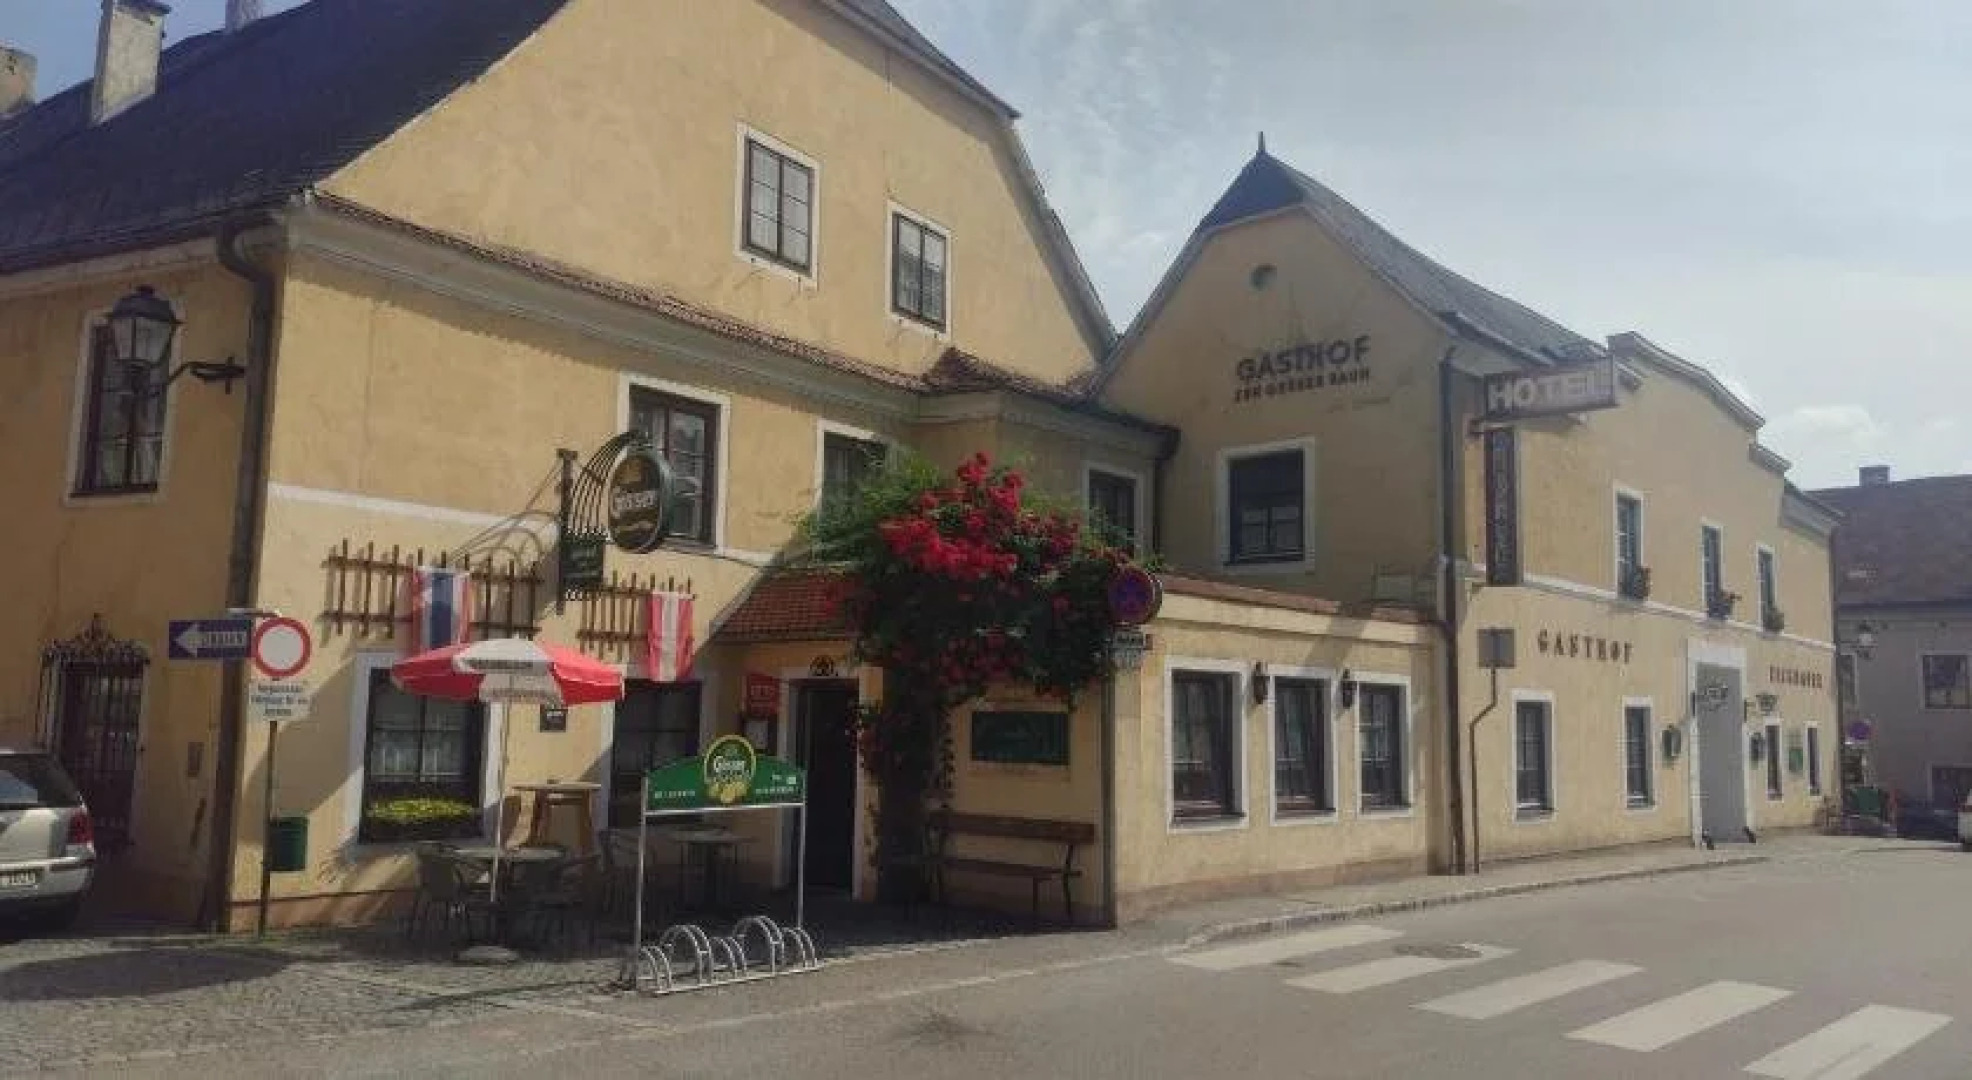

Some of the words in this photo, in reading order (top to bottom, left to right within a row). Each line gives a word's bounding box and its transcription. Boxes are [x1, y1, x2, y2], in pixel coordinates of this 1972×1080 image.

[1236, 335, 1371, 381] GASTHOF
[1487, 372, 1613, 411] HOTEL
[1537, 628, 1633, 664] GASTHOF
